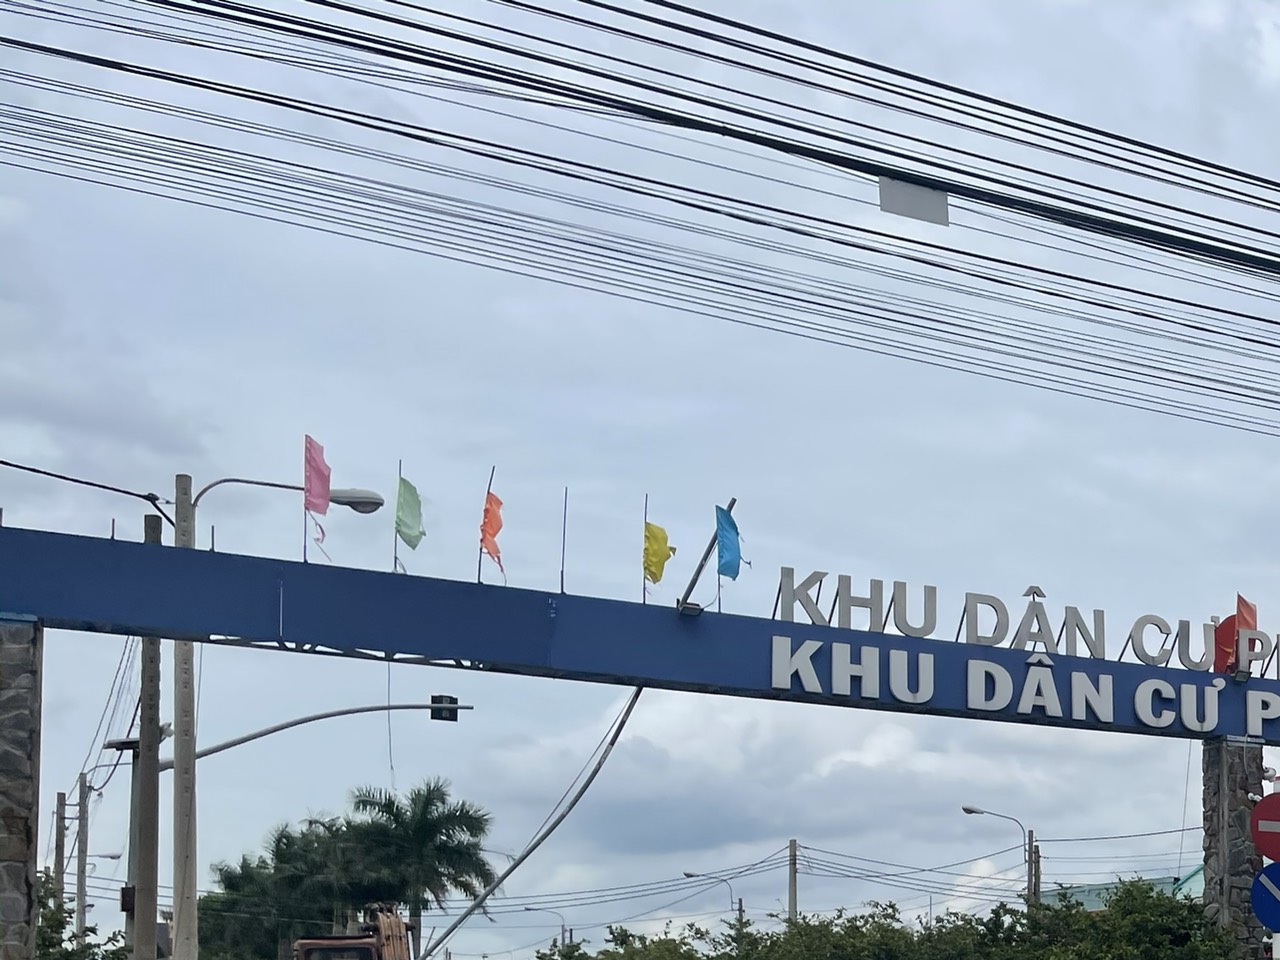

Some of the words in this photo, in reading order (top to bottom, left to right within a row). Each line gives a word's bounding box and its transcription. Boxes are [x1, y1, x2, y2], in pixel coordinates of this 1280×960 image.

[780, 566, 937, 639] KHU
[965, 585, 1105, 660] DÂN
[1130, 614, 1220, 672] CƯ
[771, 635, 935, 704] KHU
[967, 653, 1114, 723] DÂN
[1134, 677, 1227, 733] CƯ
